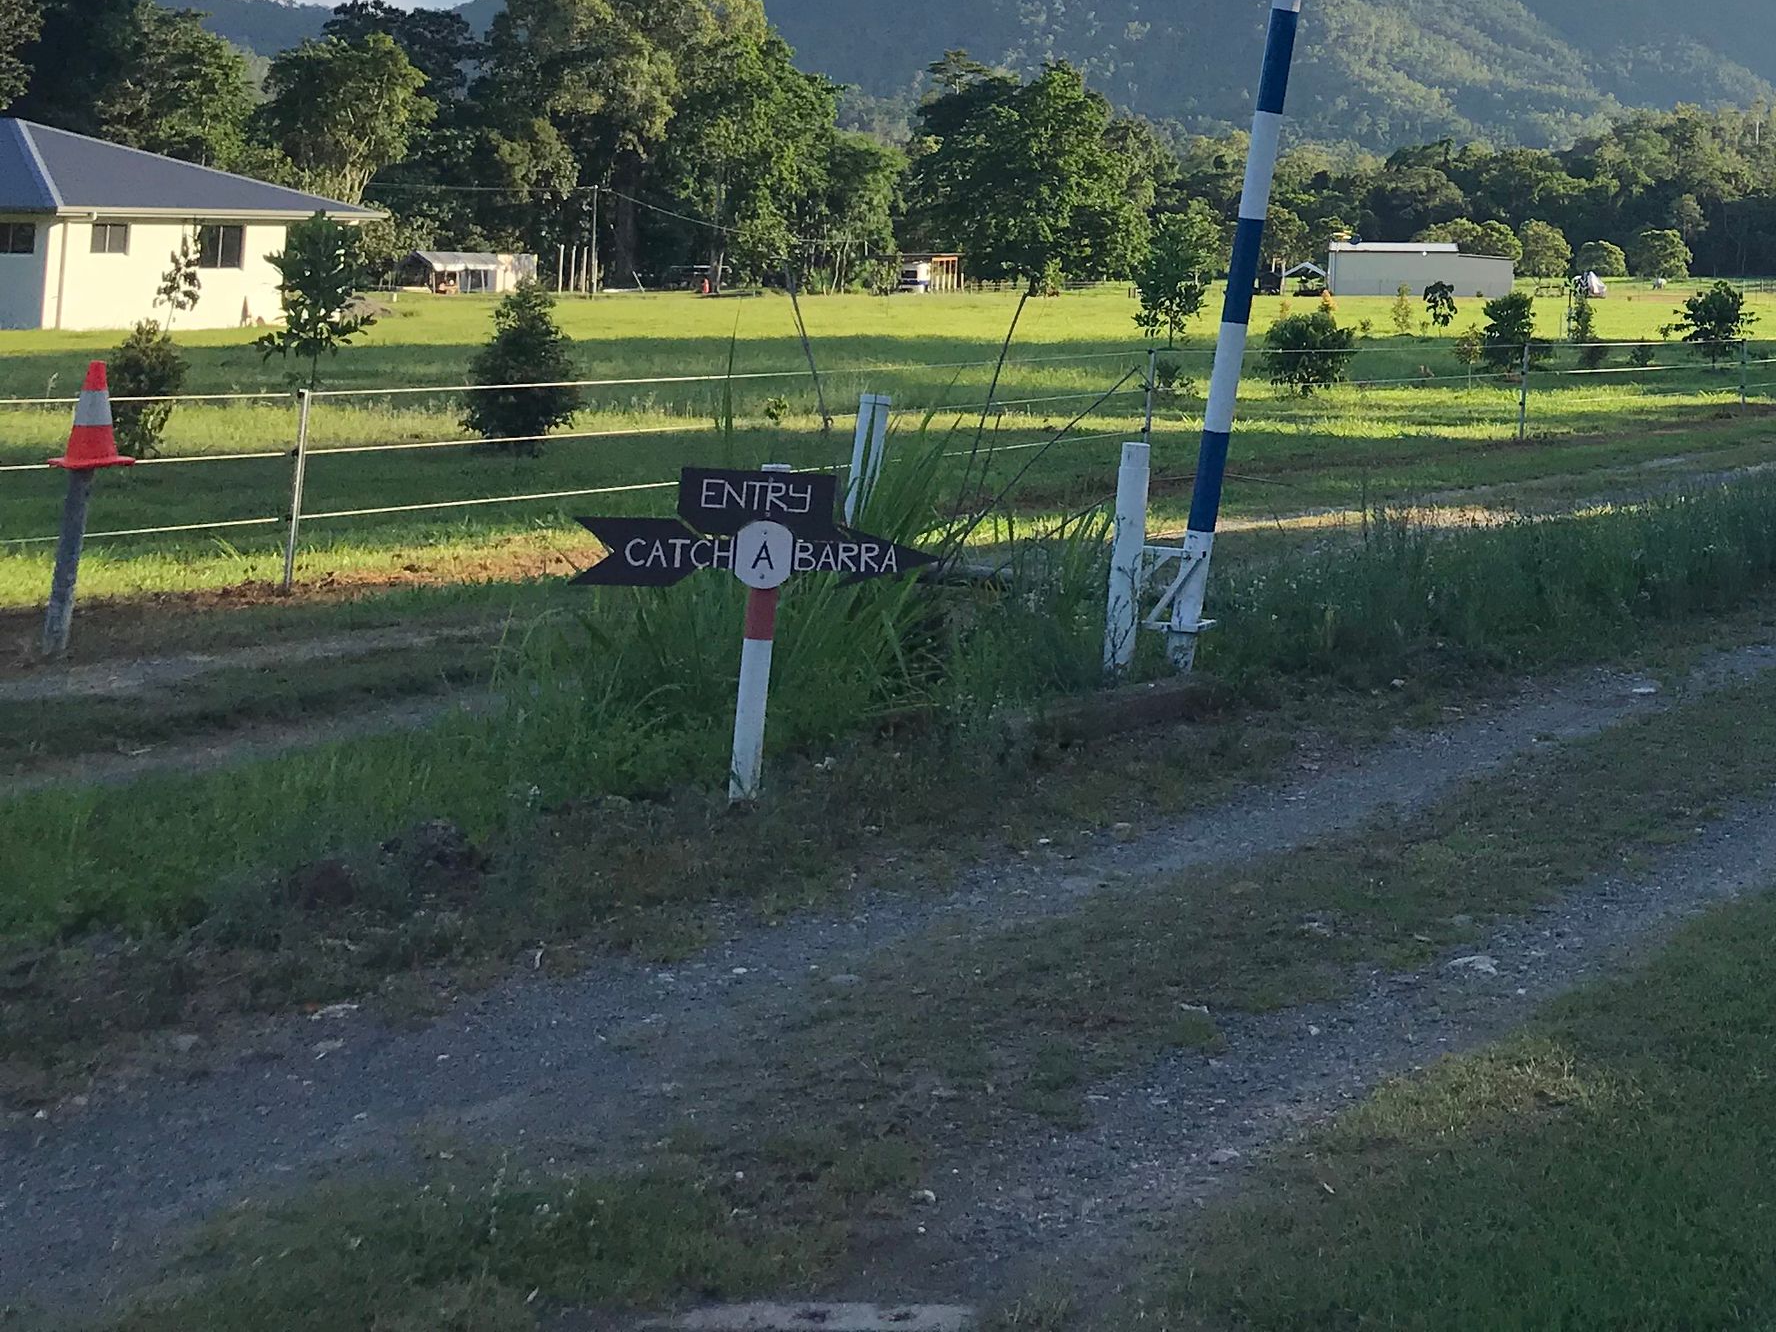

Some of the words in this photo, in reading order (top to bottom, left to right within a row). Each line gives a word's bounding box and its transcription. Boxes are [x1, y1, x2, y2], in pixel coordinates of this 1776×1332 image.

[701, 478, 812, 513] ENTRY
[623, 537, 735, 569] CATCH
[751, 541, 775, 570] A
[793, 542, 899, 573] BARRA
